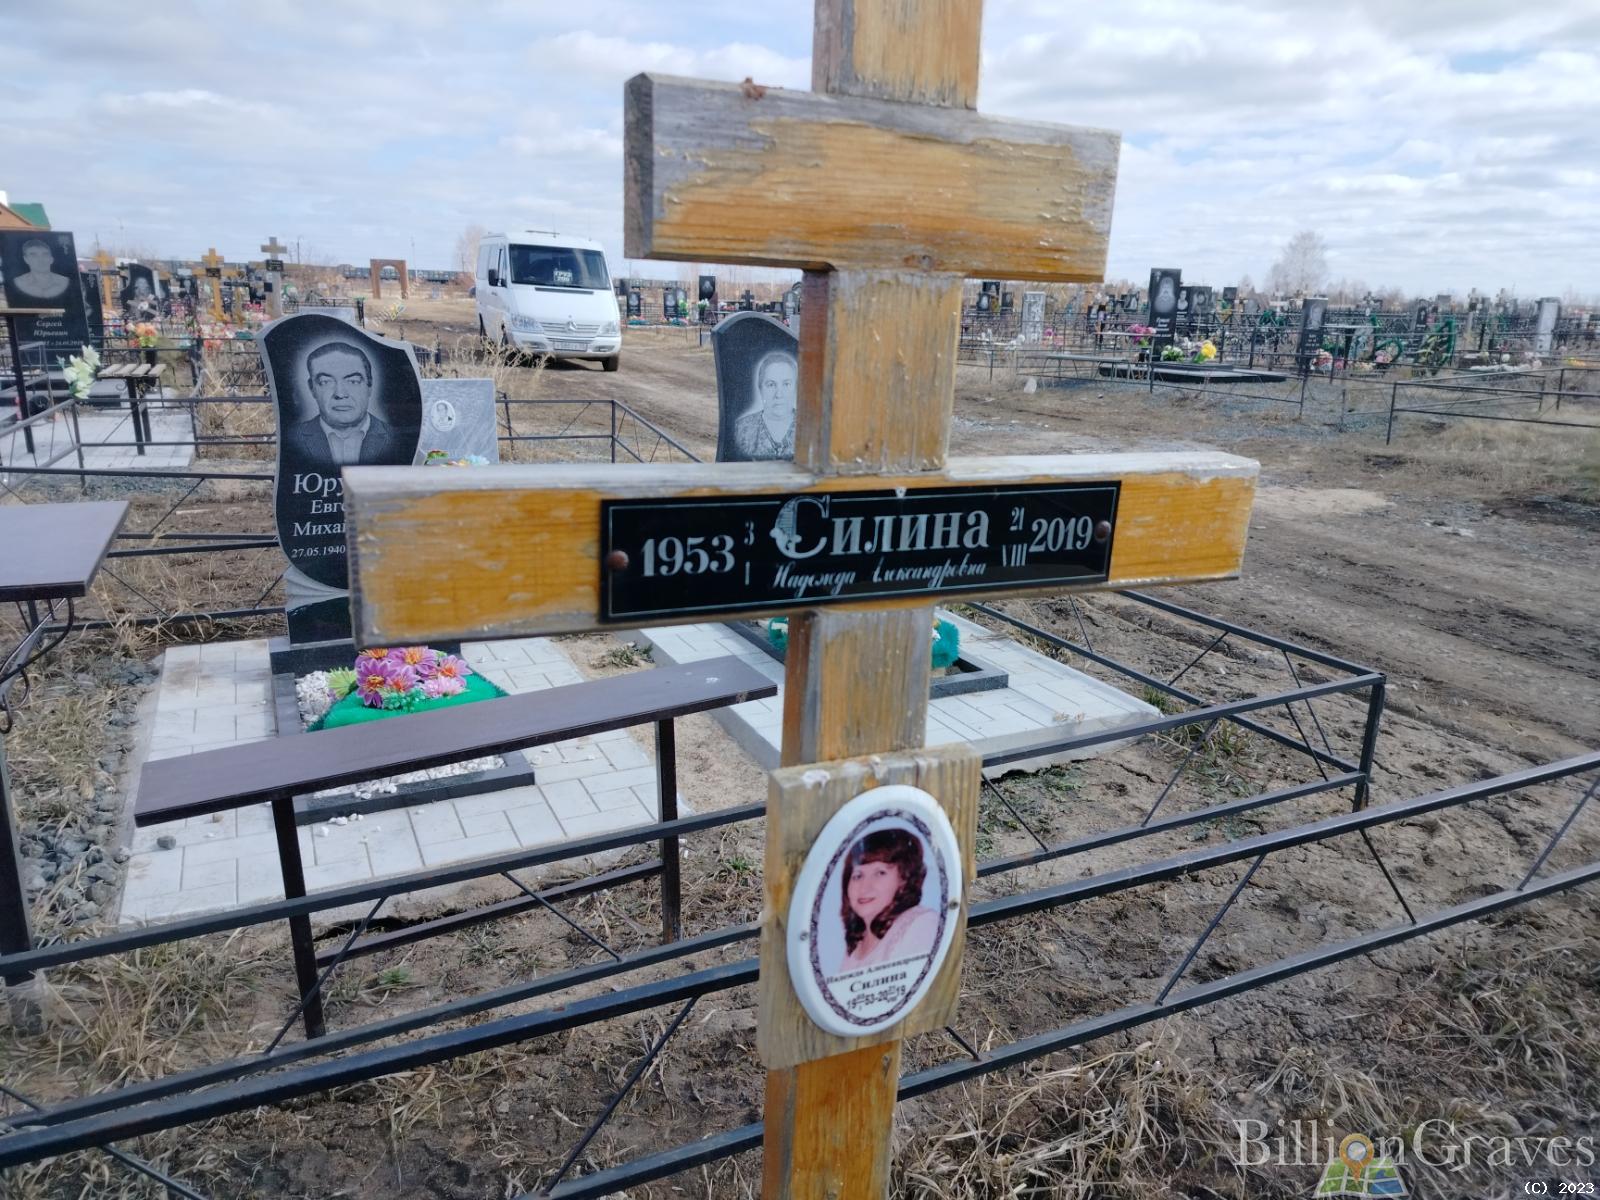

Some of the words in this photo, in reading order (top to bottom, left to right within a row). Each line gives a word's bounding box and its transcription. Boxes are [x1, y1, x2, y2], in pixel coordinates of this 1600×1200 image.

[744, 521, 755, 545] 3
[769, 495, 989, 560] Силина
[1009, 506, 1025, 531] 21
[1028, 515, 1094, 553] 2019
[291, 545, 346, 558] 27.05.1940
[641, 534, 736, 577] 1953
[771, 560, 857, 599] Надежда
[872, 552, 988, 589] Александровна
[850, 972, 908, 993] Силина
